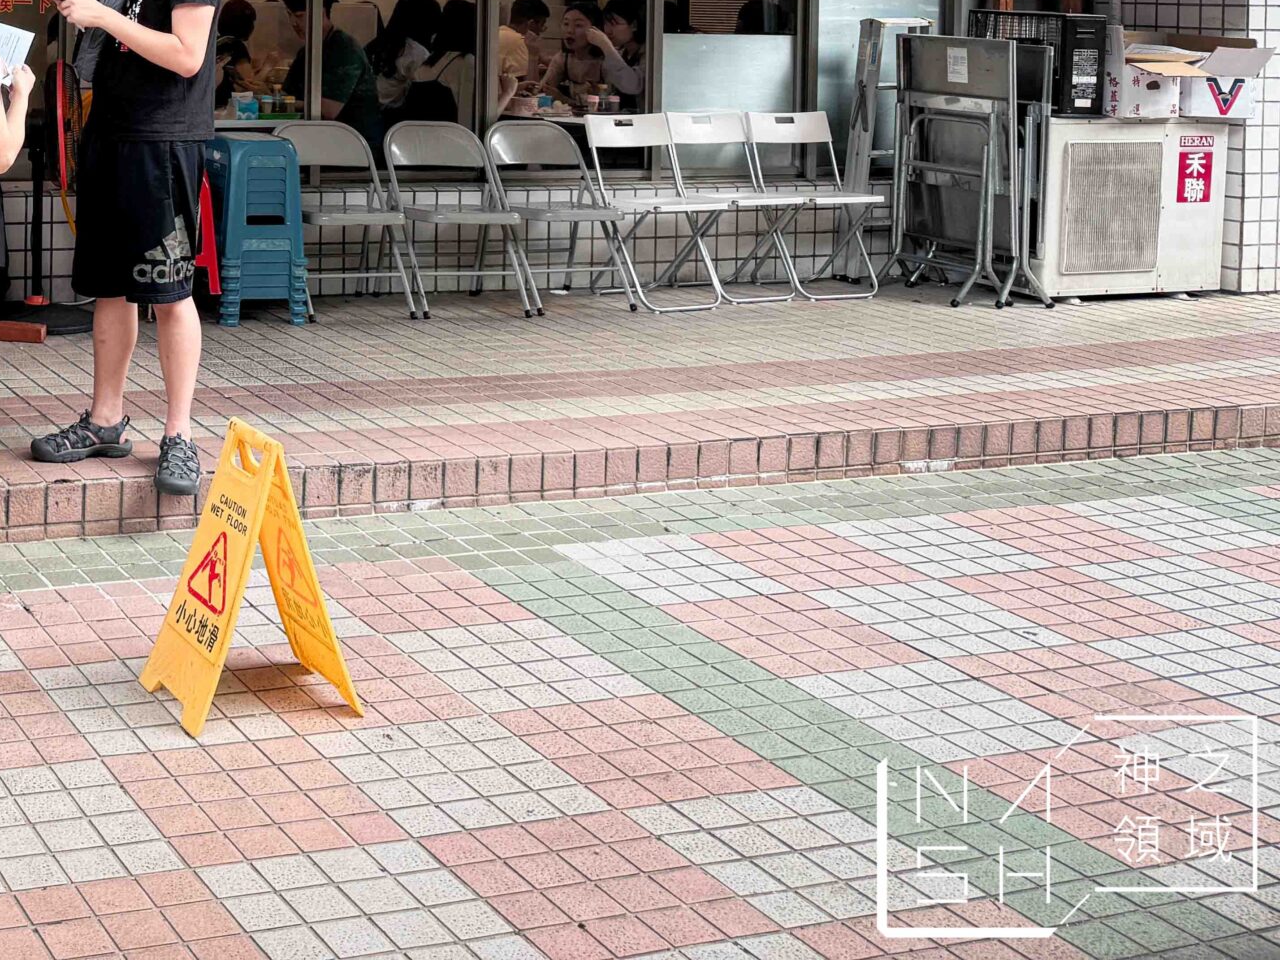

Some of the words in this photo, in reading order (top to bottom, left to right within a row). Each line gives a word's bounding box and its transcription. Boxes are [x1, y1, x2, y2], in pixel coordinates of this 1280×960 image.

[1181, 137, 1214, 146] HERAN
[1184, 153, 1205, 202] 禾聯
[210, 502, 226, 521] WET
[226, 514, 249, 537] FLOOR
[219, 494, 248, 519] CAUTION
[175, 599, 219, 654] 小心地滑
